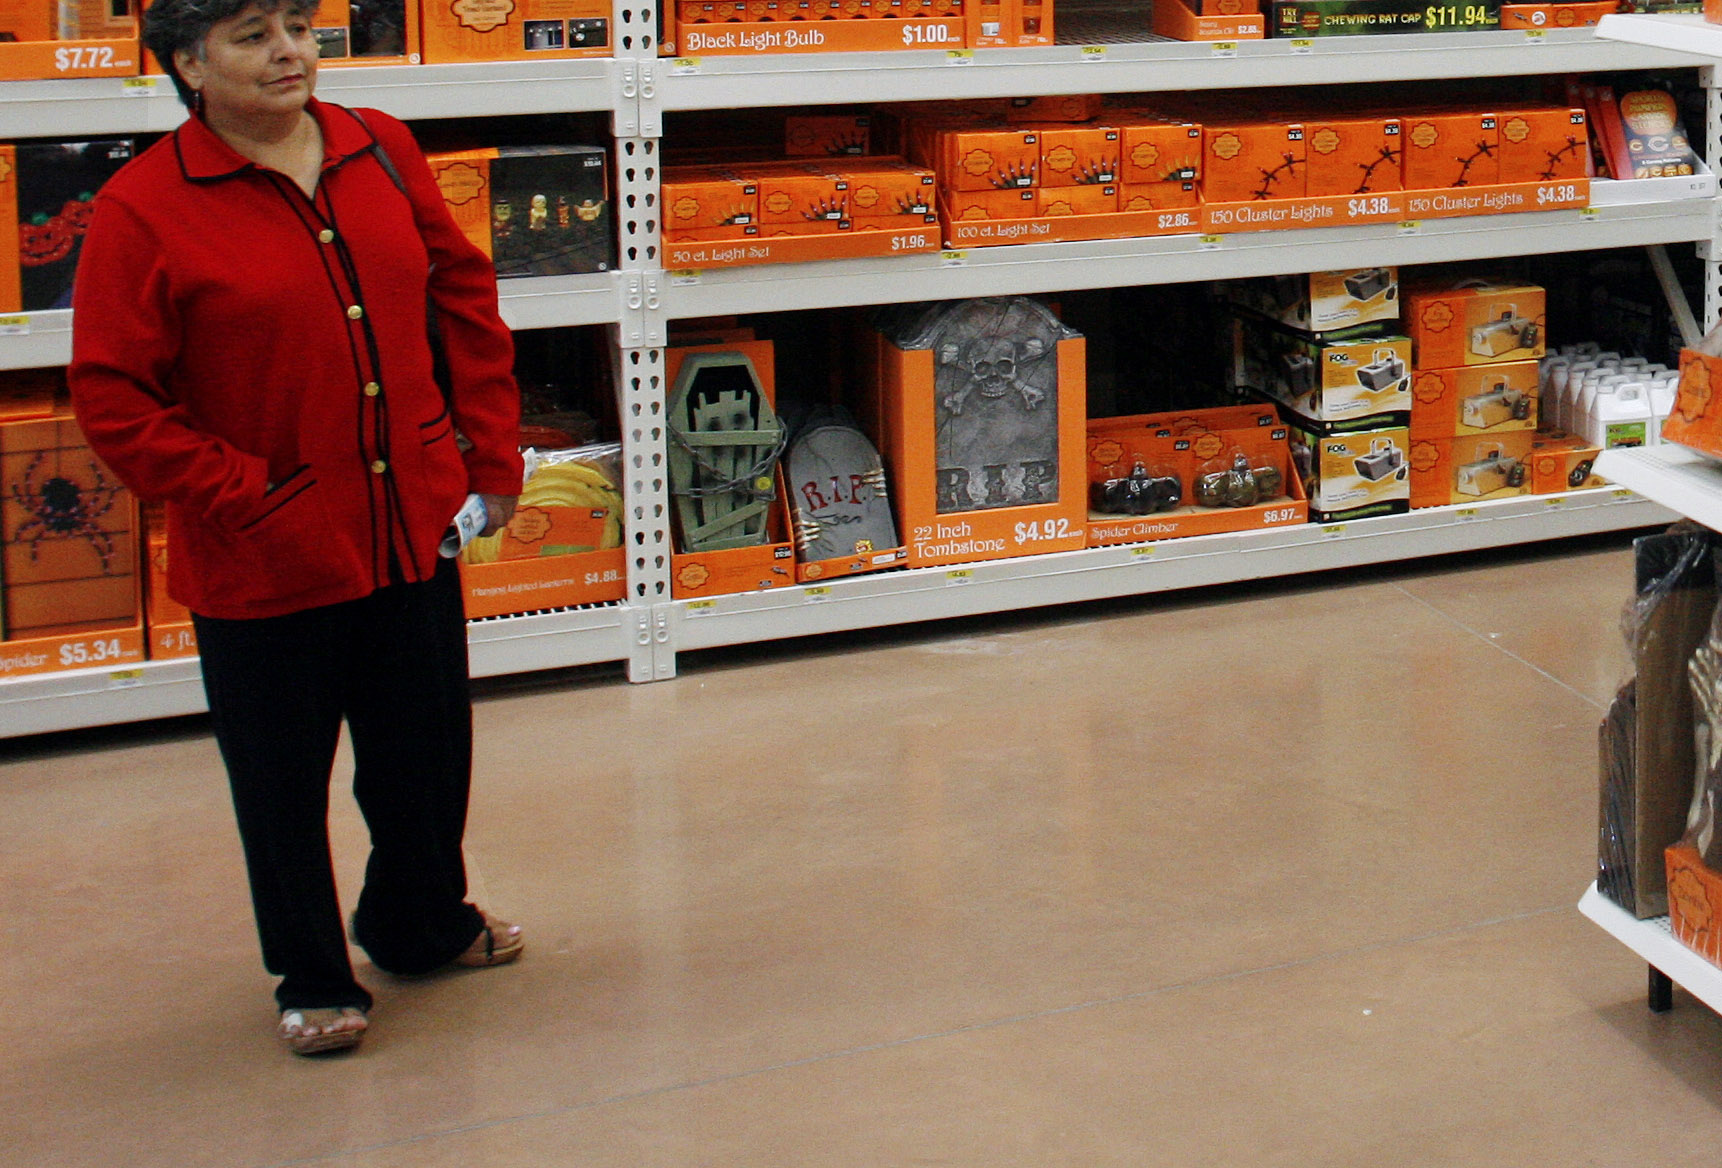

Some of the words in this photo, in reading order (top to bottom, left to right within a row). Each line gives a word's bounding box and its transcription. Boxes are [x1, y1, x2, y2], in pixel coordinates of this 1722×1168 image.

[1324, 14, 1376, 25] CHEWING
[1379, 14, 1397, 24] RAT
[1400, 13, 1422, 24] CAP
[1425, 5, 1486, 29] $11.94
[687, 32, 736, 50] Black
[739, 31, 781, 51] Light
[784, 30, 825, 47] Bulb
[902, 24, 948, 44] $1.00
[55, 48, 114, 71] $7.72
[1408, 199, 1430, 211] 150
[1432, 196, 1481, 210] Cluster
[1484, 192, 1524, 210] Lights
[1537, 185, 1576, 205] $4.38
[1210, 211, 1233, 224] 150
[1235, 207, 1287, 223] Cluster
[1291, 205, 1334, 222] Lights
[1347, 198, 1389, 218] $4.38
[1158, 213, 1190, 229] $2.86
[957, 226, 979, 239] 100
[980, 226, 994, 238] ct.
[997, 224, 1030, 239] Light
[1030, 223, 1051, 235] Set
[891, 235, 926, 251] $1.96
[672, 249, 691, 263] 50
[693, 250, 709, 262] ct.
[712, 248, 746, 263] Light
[749, 246, 770, 258] Set
[1329, 353, 1349, 362] FOG
[1327, 444, 1346, 453] FOG
[1263, 508, 1296, 524] $6.97
[913, 526, 934, 541] 22
[937, 522, 972, 540] Inch
[1014, 519, 1070, 546] $4.92
[1092, 524, 1132, 541] Spider
[1133, 521, 1180, 536] Climber
[913, 538, 1007, 560] Tombstone
[584, 569, 617, 585] $4.88
[160, 633, 175, 649] 4
[177, 630, 196, 651] ft.
[59, 638, 121, 666] $5.34
